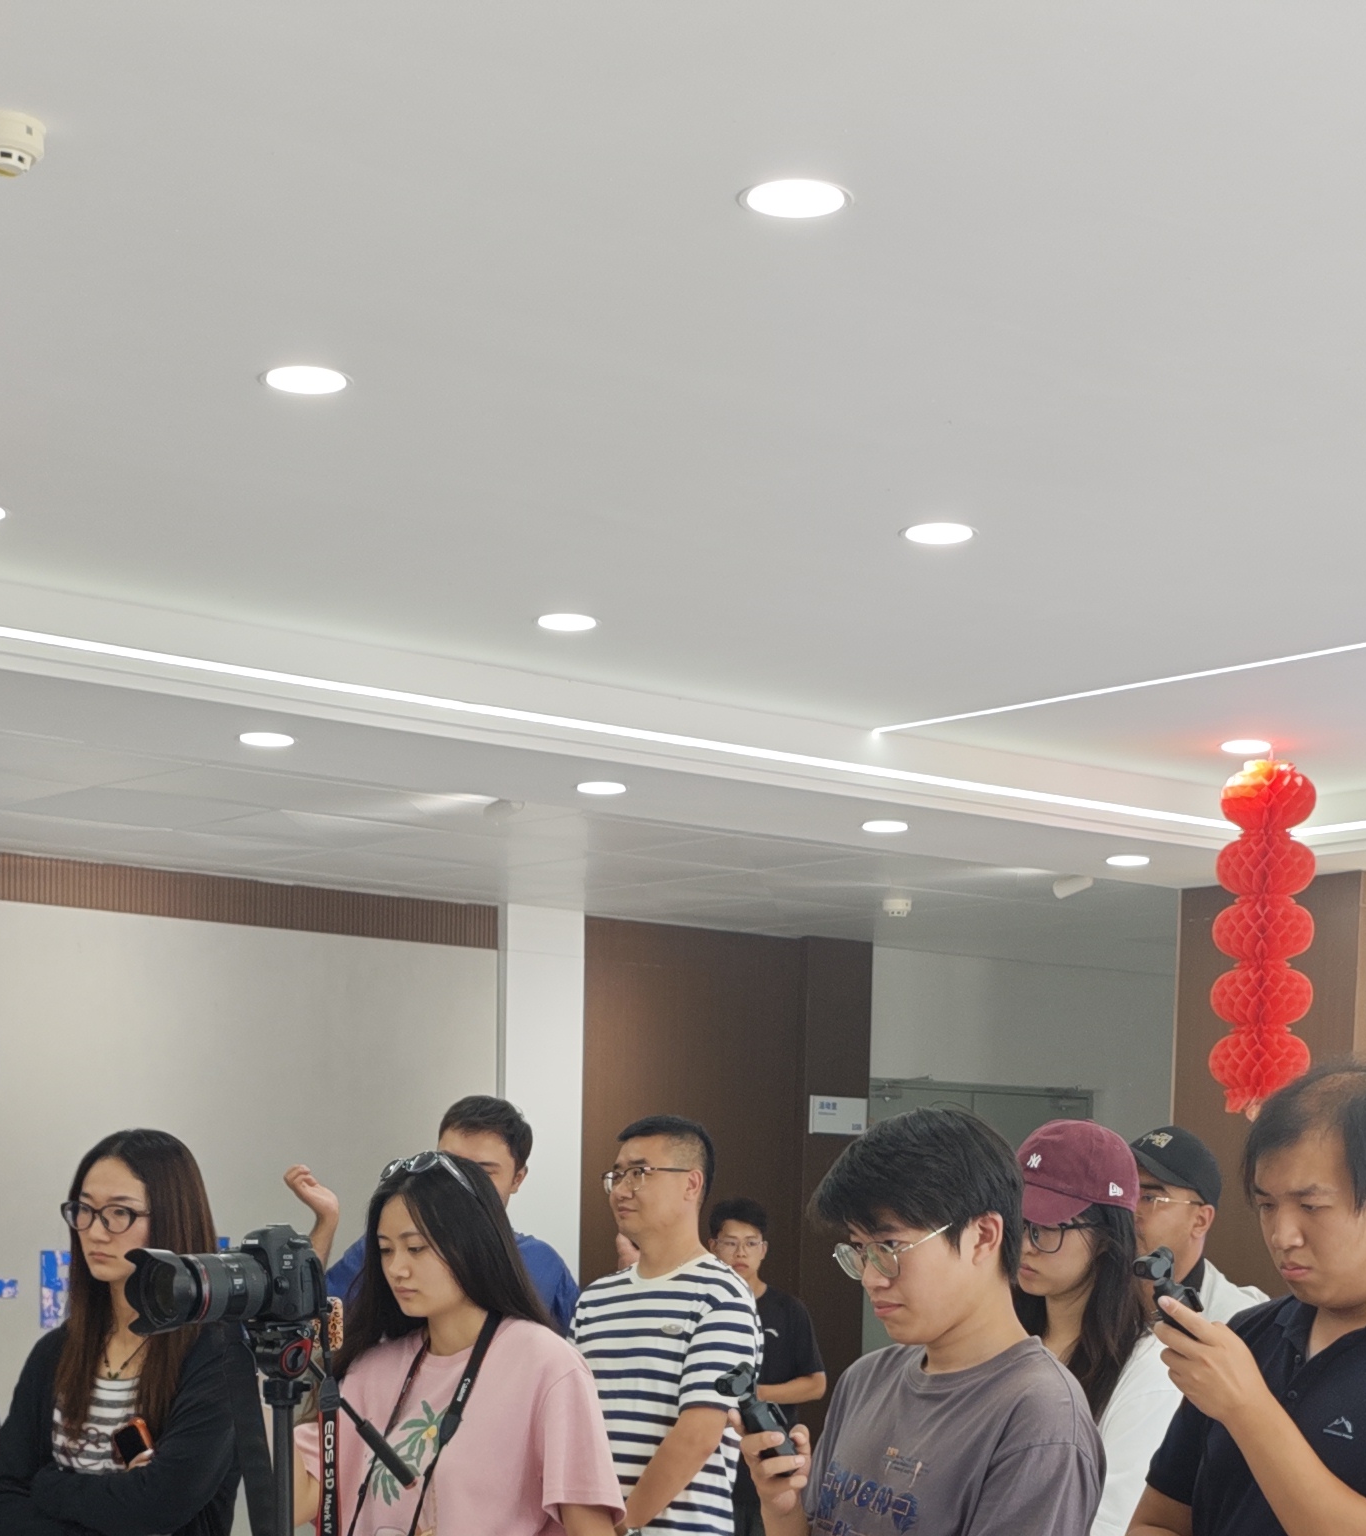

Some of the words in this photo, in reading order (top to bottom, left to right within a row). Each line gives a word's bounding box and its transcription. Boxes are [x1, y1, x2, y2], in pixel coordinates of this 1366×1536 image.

[324, 1420, 335, 1464] EOS
[325, 1468, 335, 1490] 5D
[323, 1494, 333, 1522] Mark
[324, 1523, 333, 1534] IV
